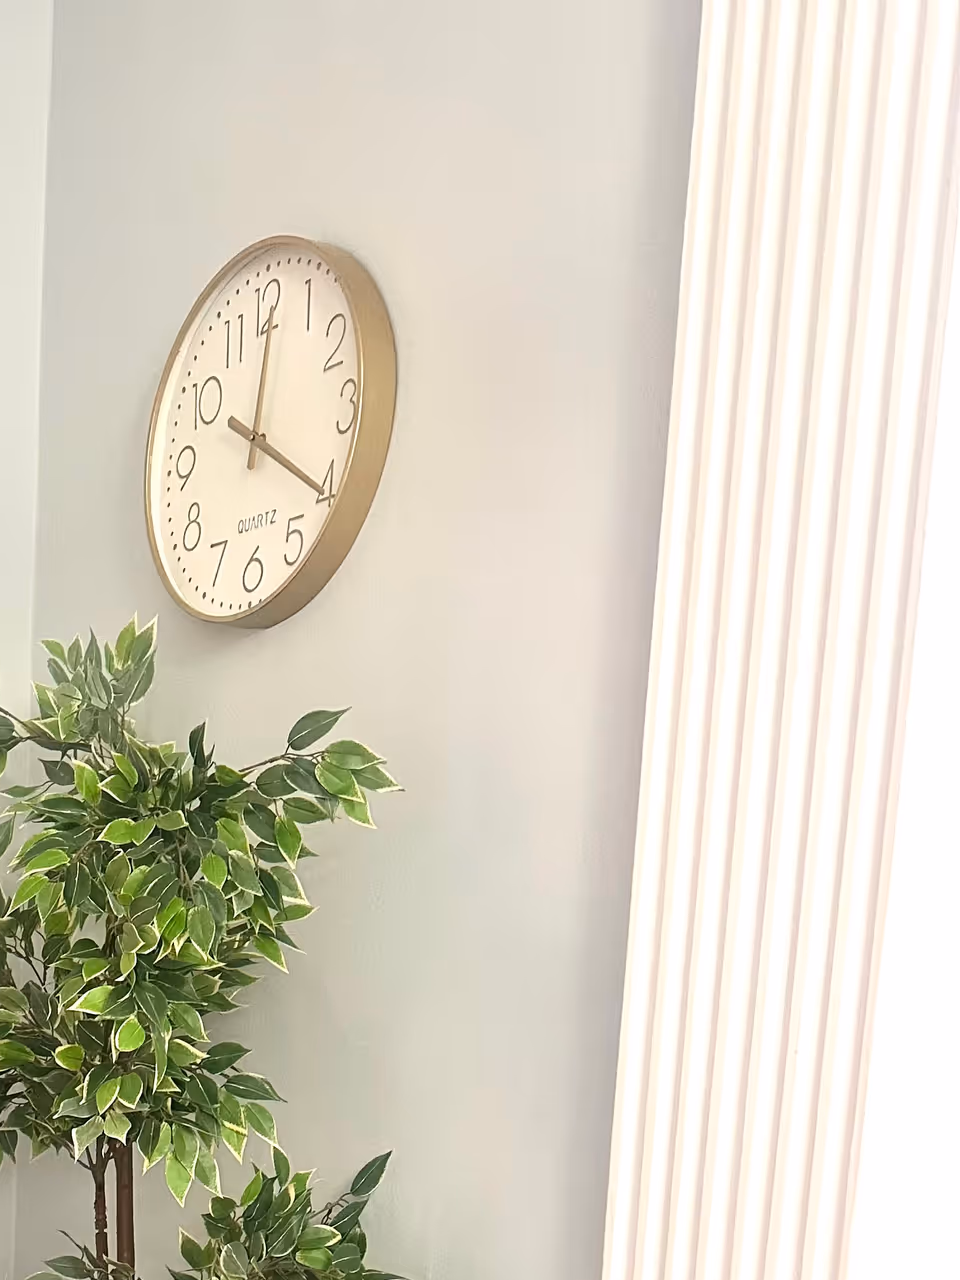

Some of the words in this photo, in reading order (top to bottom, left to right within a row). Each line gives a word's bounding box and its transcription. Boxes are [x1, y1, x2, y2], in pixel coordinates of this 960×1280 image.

[255, 278, 281, 338] 12
[305, 278, 312, 332] 1
[224, 313, 244, 369] 11
[323, 312, 346, 372] 2
[192, 376, 223, 431] 10
[336, 378, 358, 434] 3
[176, 445, 196, 492] 9
[316, 459, 337, 508] 4
[183, 502, 202, 552] 8
[237, 507, 277, 536] QUARTZ
[284, 513, 305, 566] 5
[210, 539, 228, 587] 7
[243, 545, 264, 593] 6
